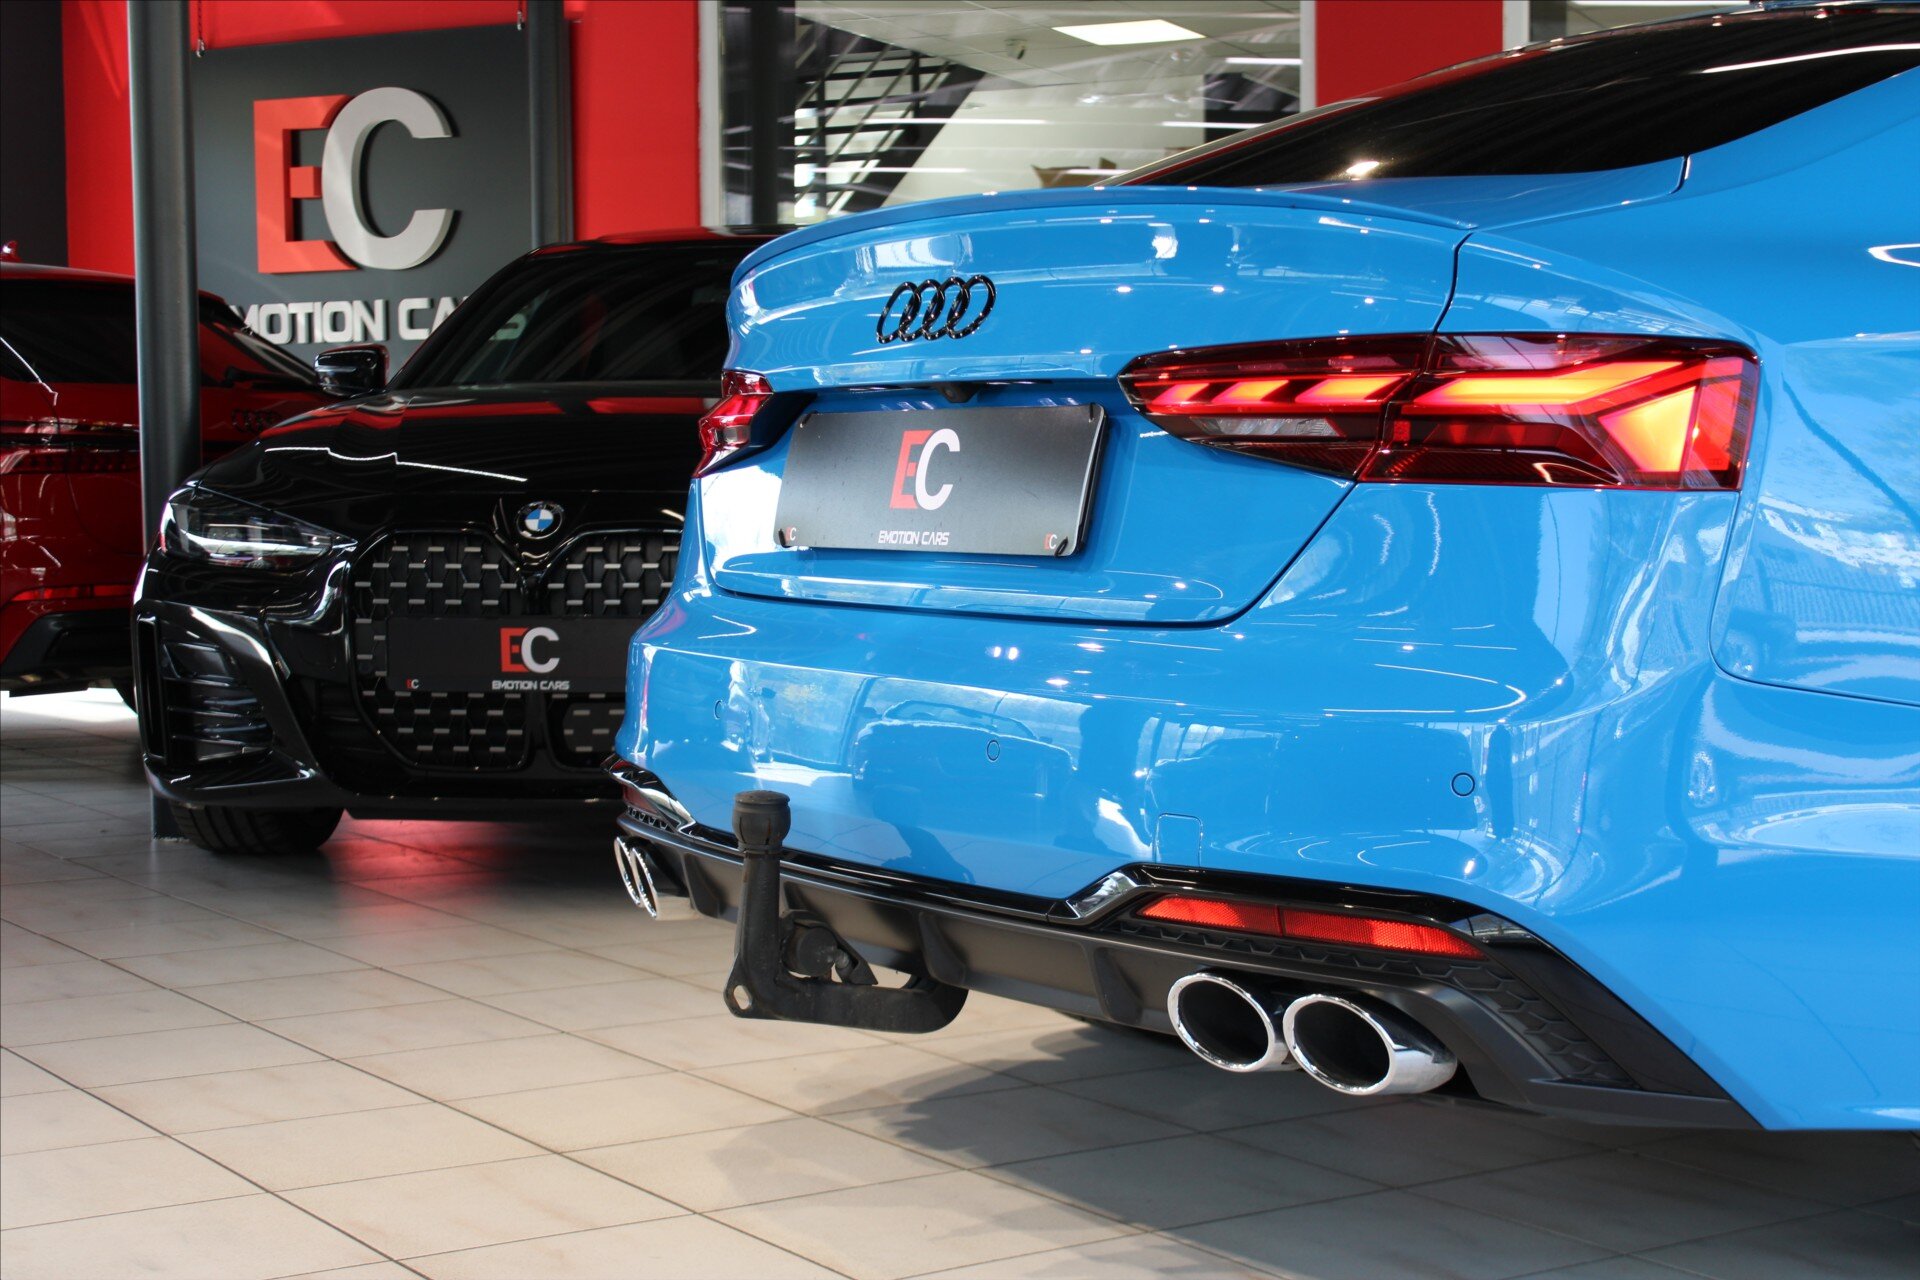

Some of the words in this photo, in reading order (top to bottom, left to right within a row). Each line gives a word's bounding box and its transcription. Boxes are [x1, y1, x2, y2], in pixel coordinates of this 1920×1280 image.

[253, 86, 455, 273] EC
[229, 300, 387, 344] MOTION
[889, 428, 960, 510] EC
[878, 530, 920, 545] EMOTION
[921, 531, 950, 546] CARS
[500, 627, 560, 673] EC
[491, 680, 538, 690] EMOTION
[540, 680, 570, 691] CARS
